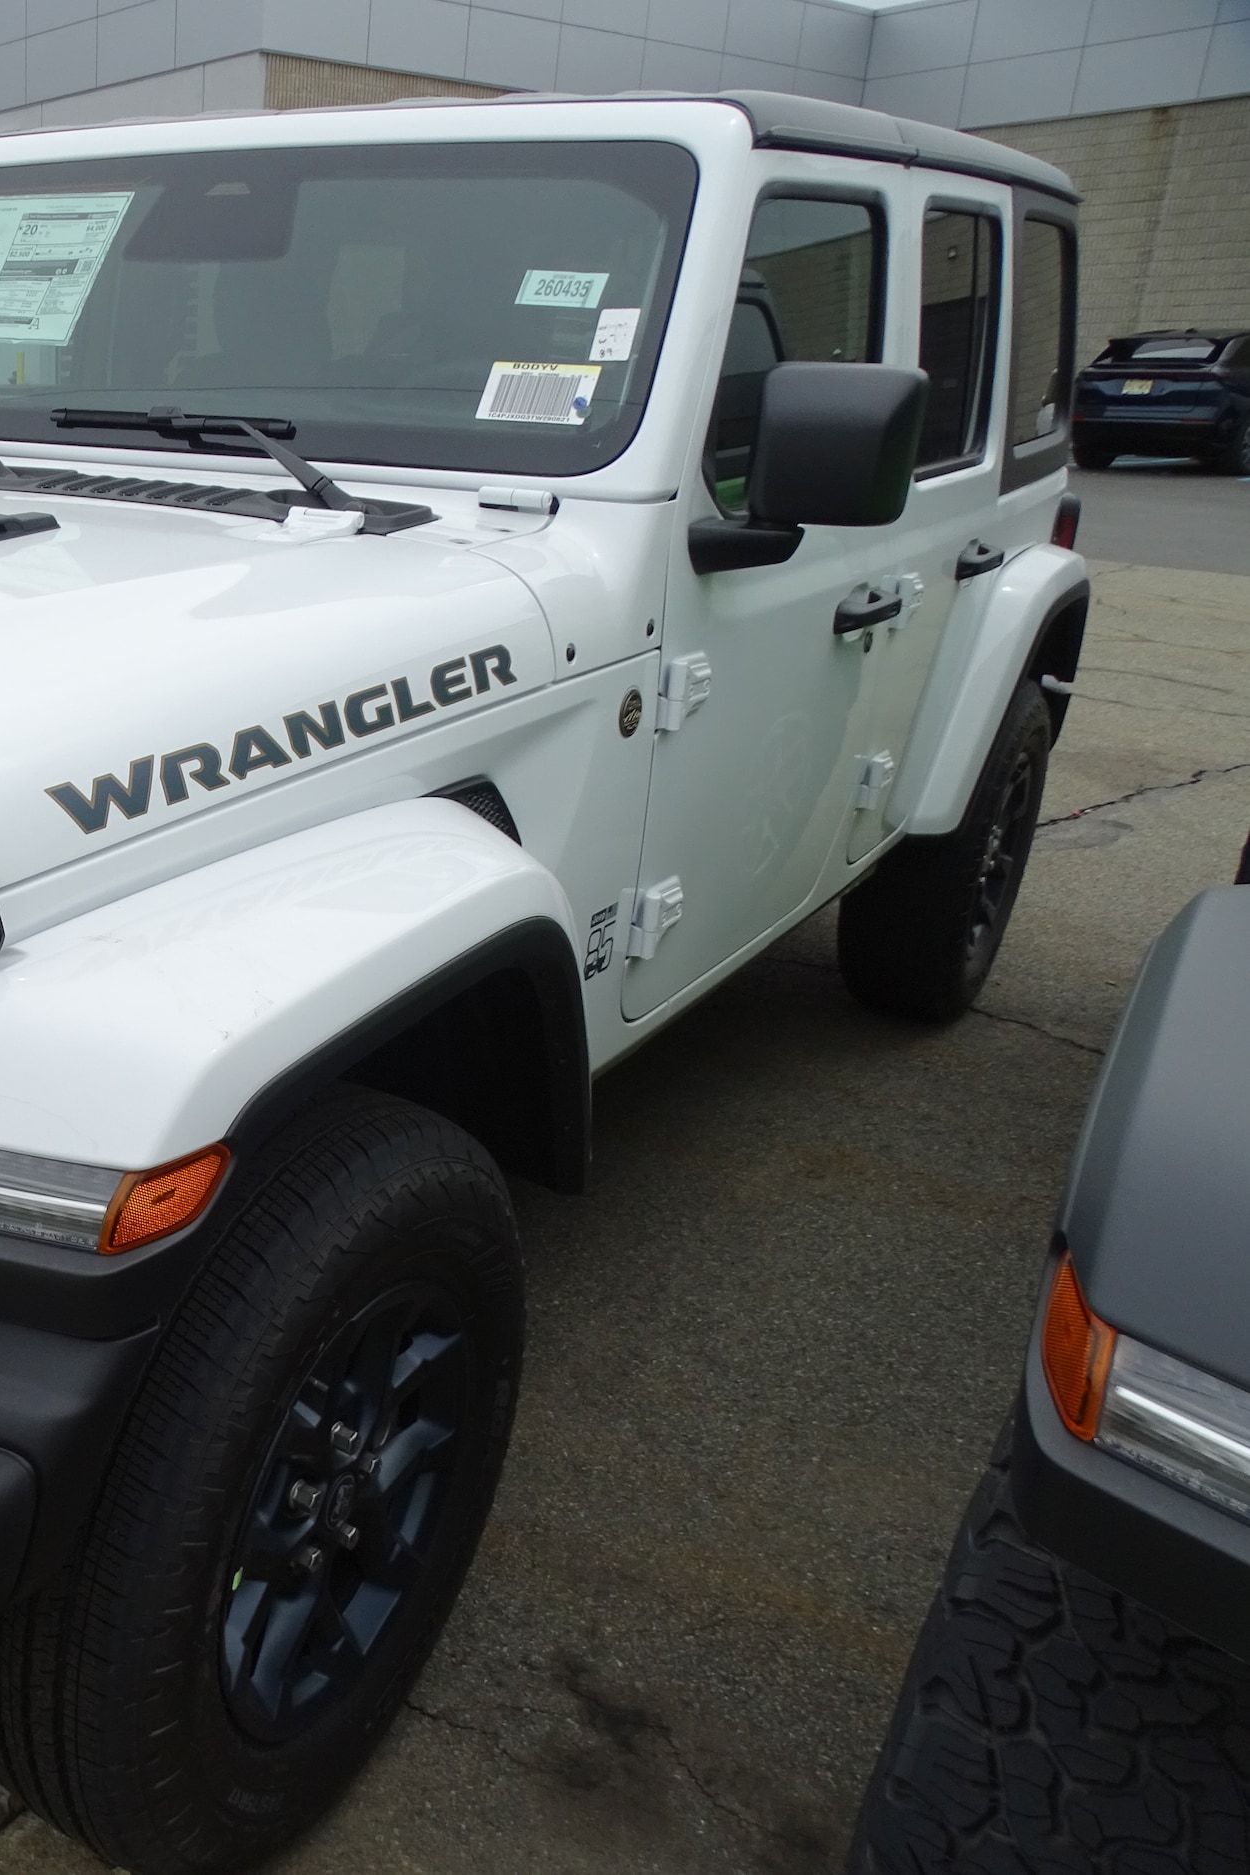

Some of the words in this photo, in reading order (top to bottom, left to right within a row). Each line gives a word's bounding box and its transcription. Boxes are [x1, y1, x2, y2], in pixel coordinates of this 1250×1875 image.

[22, 223, 39, 236] 20
[534, 279, 592, 298] 260435
[512, 362, 559, 371] BODYV
[44, 644, 518, 834] WRANGLER
